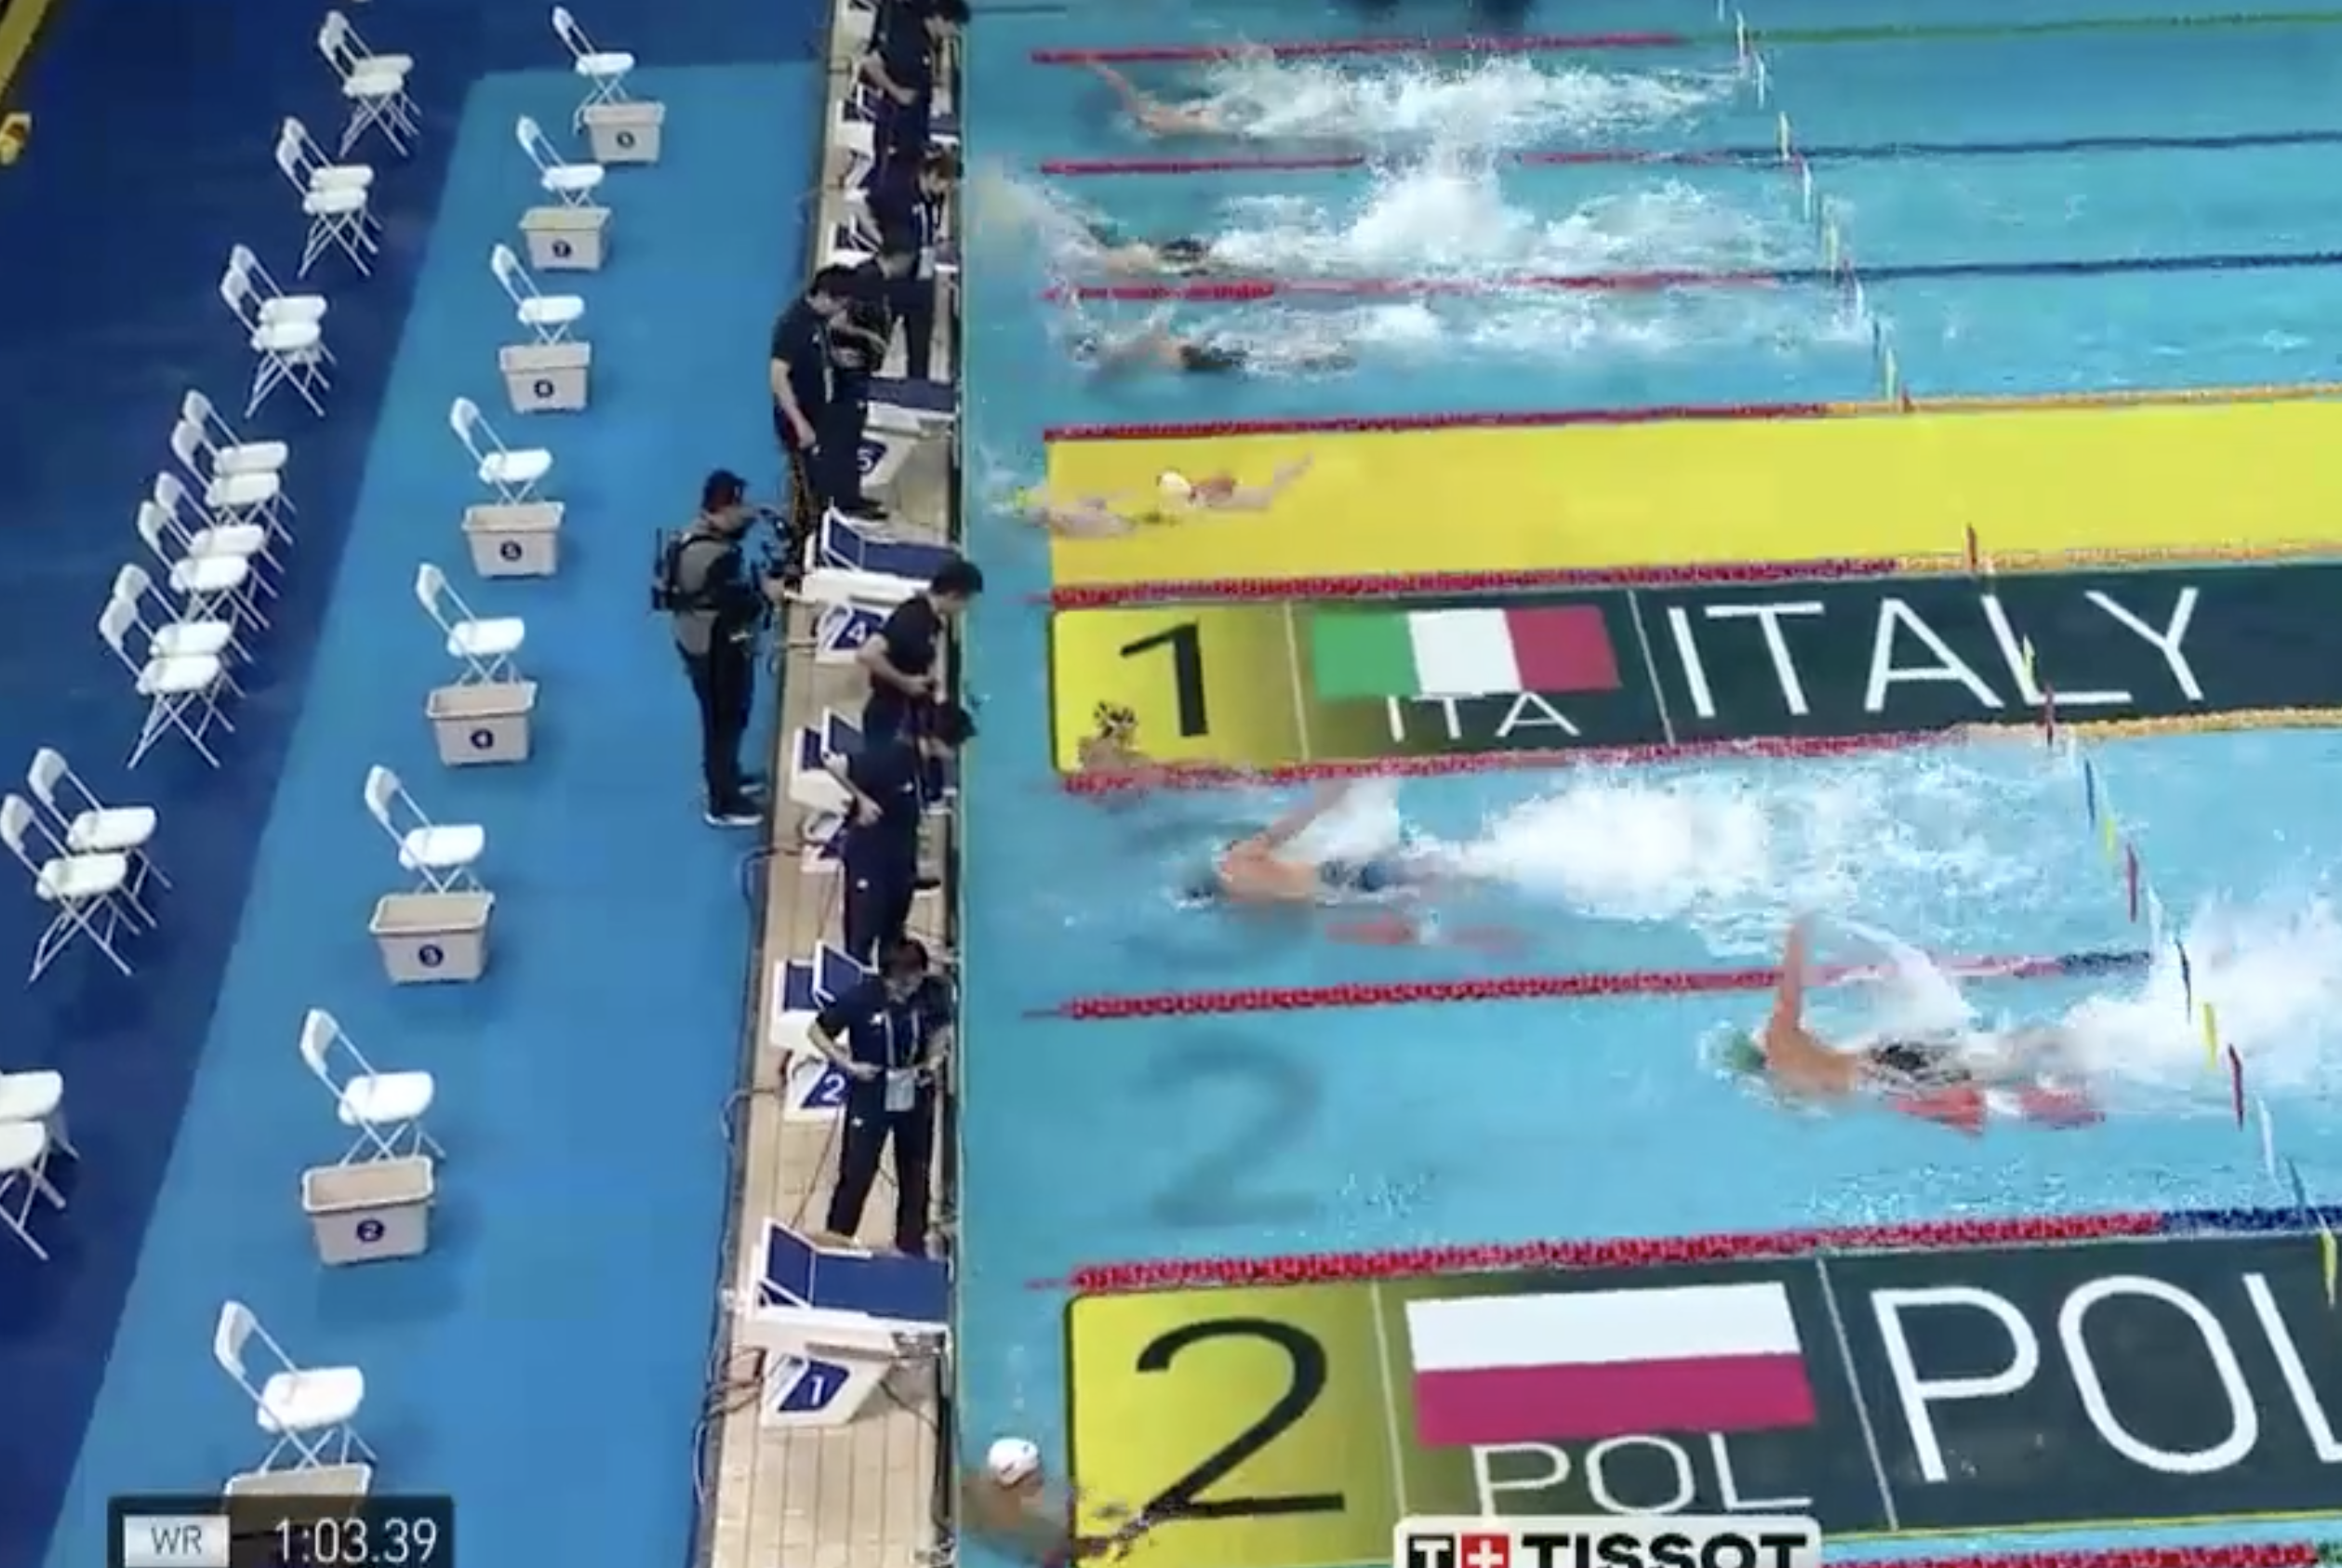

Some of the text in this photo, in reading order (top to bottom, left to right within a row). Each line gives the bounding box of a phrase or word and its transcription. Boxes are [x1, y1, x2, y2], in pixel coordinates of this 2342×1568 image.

[857, 446, 873, 472] 5
[846, 620, 866, 644] 4
[821, 1072, 845, 1103] 2
[1137, 1030, 1325, 1228] 2
[812, 1375, 825, 1406] 1
